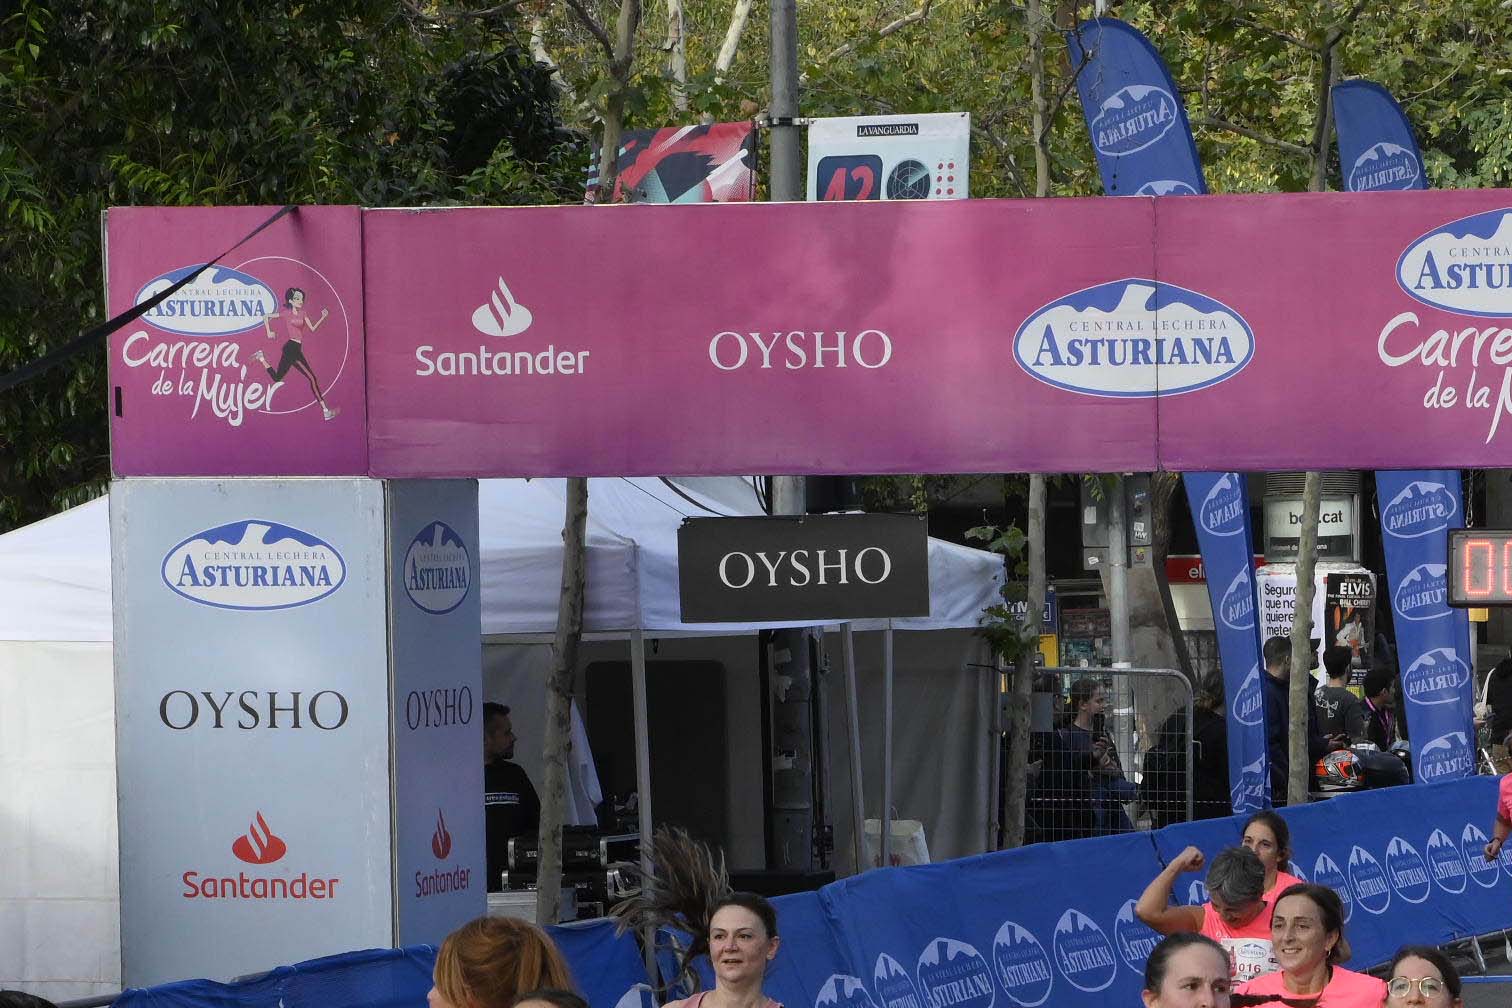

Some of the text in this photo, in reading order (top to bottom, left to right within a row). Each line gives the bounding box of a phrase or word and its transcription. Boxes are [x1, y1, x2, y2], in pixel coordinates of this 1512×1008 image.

[869, 124, 918, 135] VANGUARDIA
[145, 291, 266, 317] ASTURIANA
[175, 287, 262, 296] ENTRAL LECHERA
[1069, 319, 1228, 331] CENTRAL LECHERA
[122, 331, 241, 370] Carrera
[416, 344, 590, 376] Santander
[709, 330, 893, 371] OYSHO
[1032, 324, 1236, 367] ASTURIANA
[151, 364, 285, 427] de la Mujer
[1422, 374, 1457, 409] de
[1466, 370, 1490, 409] la
[176, 553, 333, 588] ASTURIANA
[204, 551, 327, 560] CENTRAL LECHERA
[718, 547, 892, 589] OYSHO
[408, 554, 468, 592] ASTURIANA
[1340, 582, 1370, 595] ELVIS
[1265, 599, 1282, 610] que
[159, 690, 349, 731] OYSHO
[406, 685, 473, 732] OYSHO
[182, 871, 339, 900] Santander
[415, 866, 471, 898] Santander
[1000, 959, 1050, 989] ASTURIANA
[1059, 944, 1115, 975] ASTURIANA
[1238, 963, 1261, 974] 016
